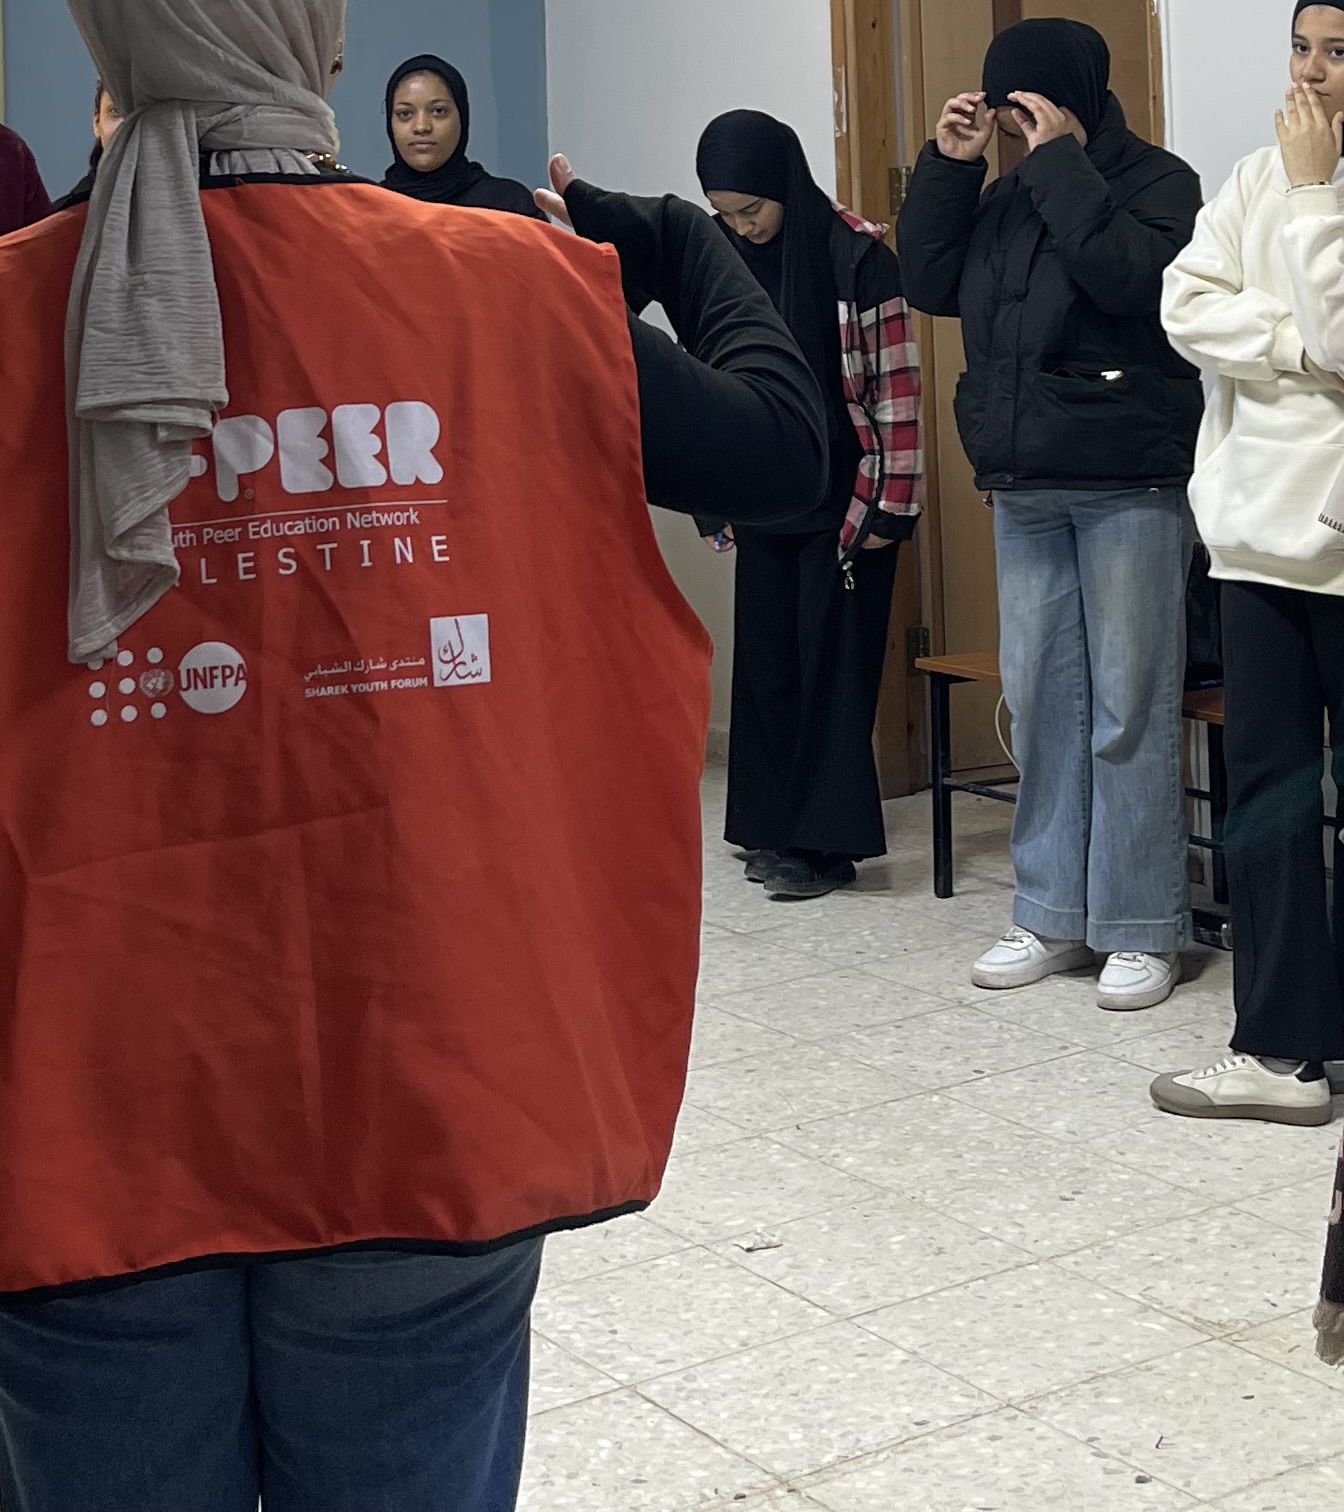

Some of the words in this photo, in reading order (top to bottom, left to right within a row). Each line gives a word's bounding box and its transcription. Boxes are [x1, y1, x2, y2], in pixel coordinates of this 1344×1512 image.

[202, 527, 243, 545] Peer
[247, 515, 340, 539] Education
[346, 506, 420, 530] Network
[199, 534, 450, 584] LESTINE
[178, 662, 248, 692] UNFPA
[354, 656, 388, 675] شارك
[304, 684, 349, 699] SHAREK
[351, 679, 388, 694] YOUTH
[391, 676, 428, 690] FORUM
